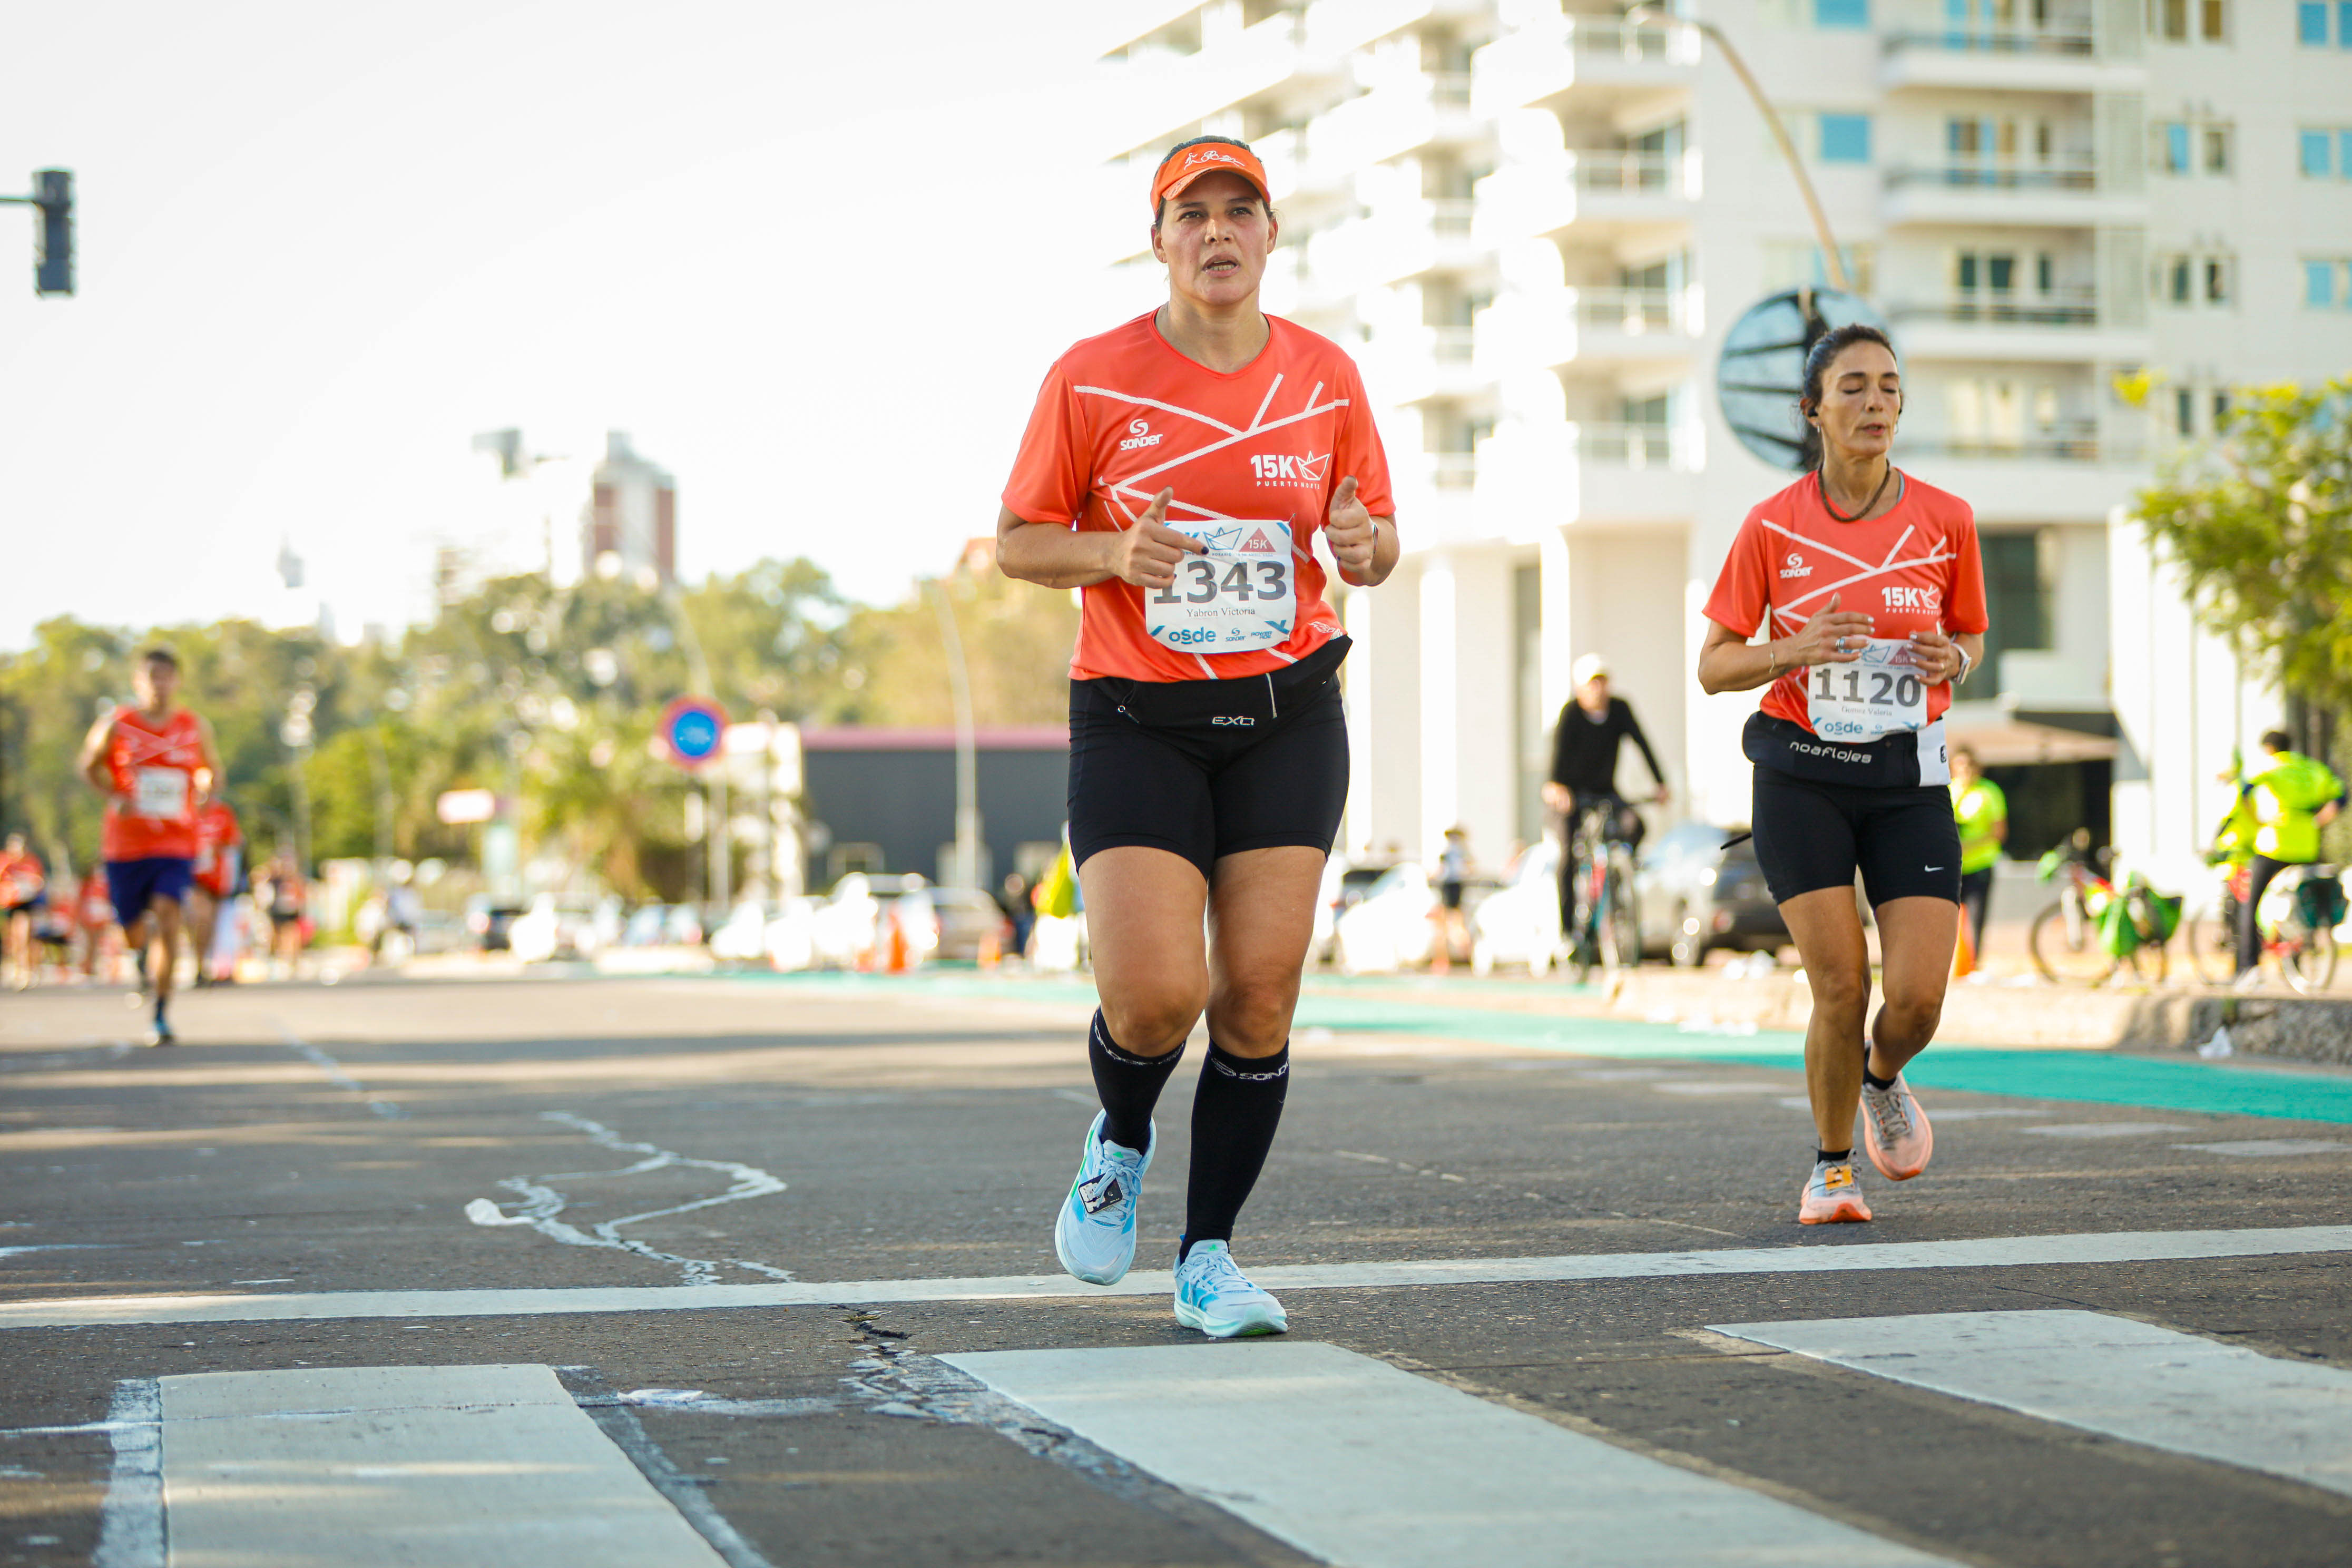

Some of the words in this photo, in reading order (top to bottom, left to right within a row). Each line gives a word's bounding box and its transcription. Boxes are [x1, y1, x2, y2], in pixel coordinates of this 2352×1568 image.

[1250, 455, 1297, 478] 15K
[1248, 539, 1267, 549] 15K
[1881, 586, 1919, 607] 15K
[1187, 609, 1218, 618] Yabron
[1221, 607, 1256, 616] Victoria
[1169, 626, 1217, 644] osde
[1815, 668, 1921, 707] 1120
[1825, 721, 1864, 735] osde
[1789, 741, 1872, 764] noaflojes
